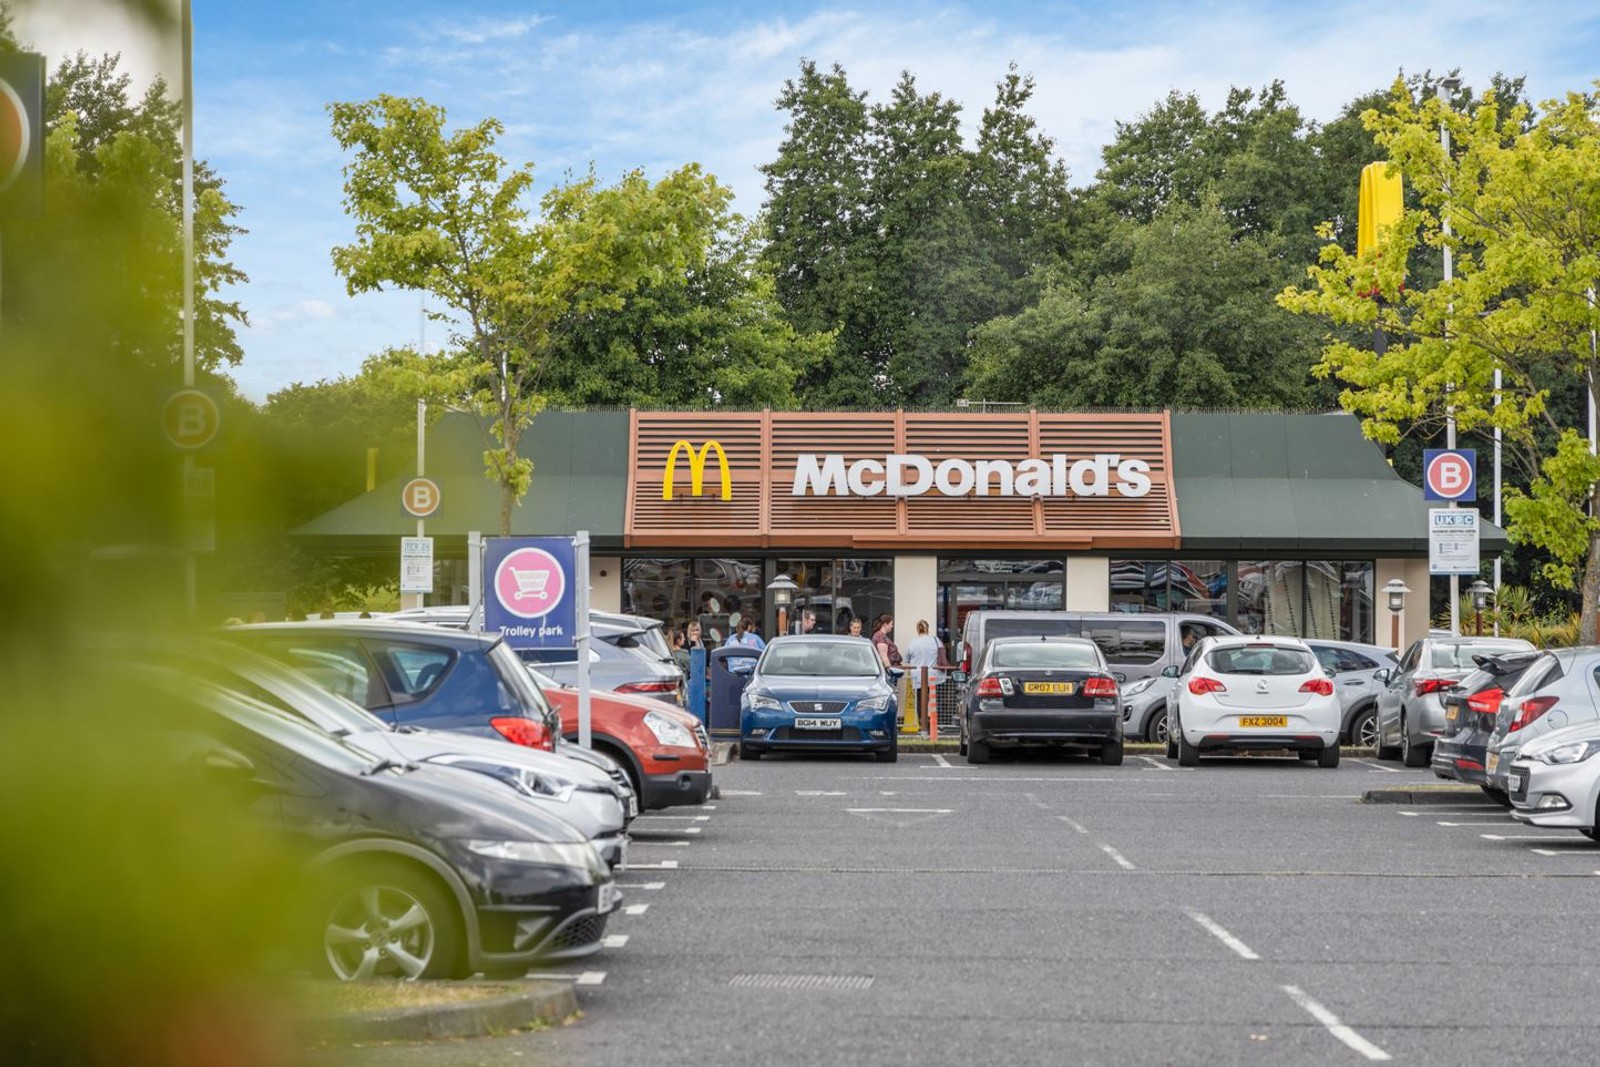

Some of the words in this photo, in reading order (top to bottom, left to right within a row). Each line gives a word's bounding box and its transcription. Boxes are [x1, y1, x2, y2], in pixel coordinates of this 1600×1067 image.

[178, 402, 207, 437] B
[791, 453, 1152, 498] McDonald's
[1440, 462, 1463, 489] B
[413, 486, 432, 509] B
[1435, 515, 1473, 525] UKPC
[499, 625, 536, 638] Trolley
[538, 625, 564, 637] park
[1242, 717, 1260, 726] FXZ
[1261, 717, 1284, 726] 3004
